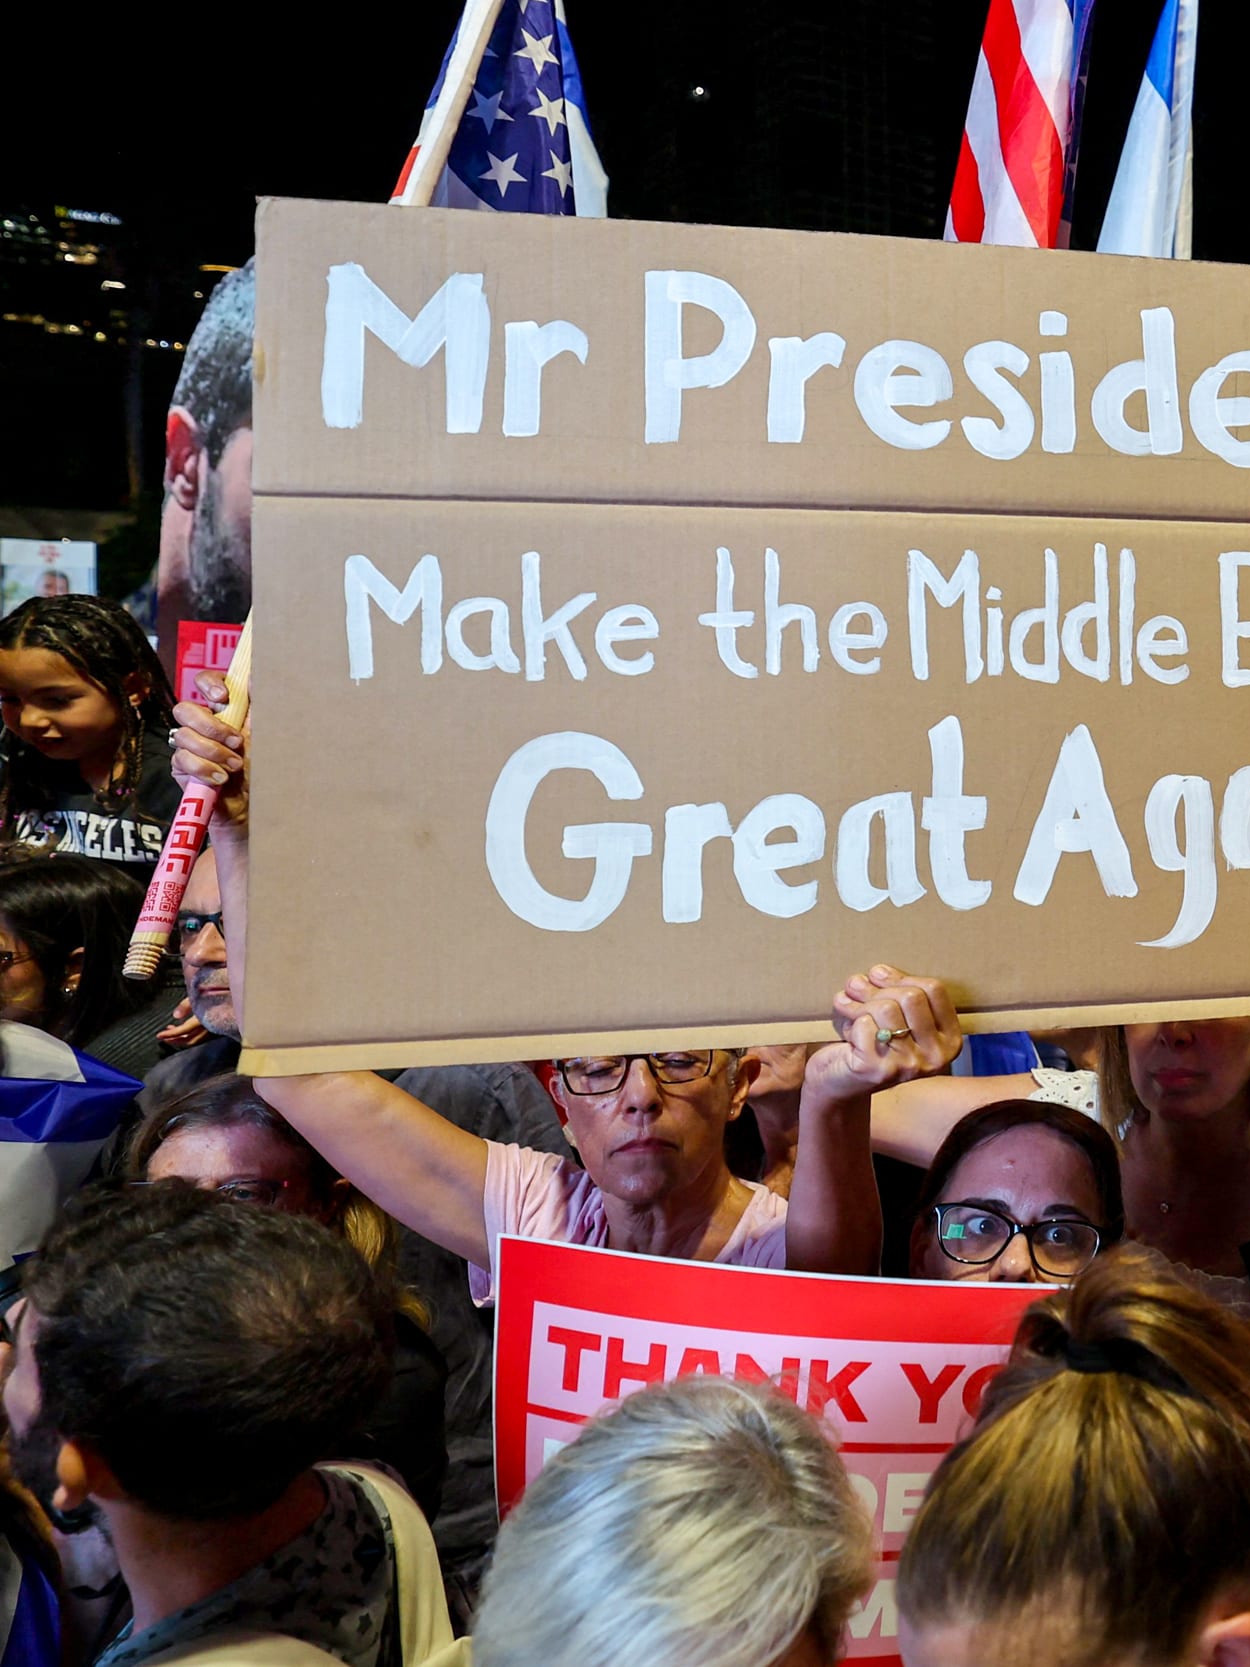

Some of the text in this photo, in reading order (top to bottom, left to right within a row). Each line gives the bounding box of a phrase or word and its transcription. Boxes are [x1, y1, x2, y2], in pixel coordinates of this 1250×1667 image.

[320, 261, 589, 439] Mr
[344, 551, 660, 686] Make
[698, 546, 888, 680] the
[906, 542, 1191, 687] Middle
[484, 714, 992, 932] Great
